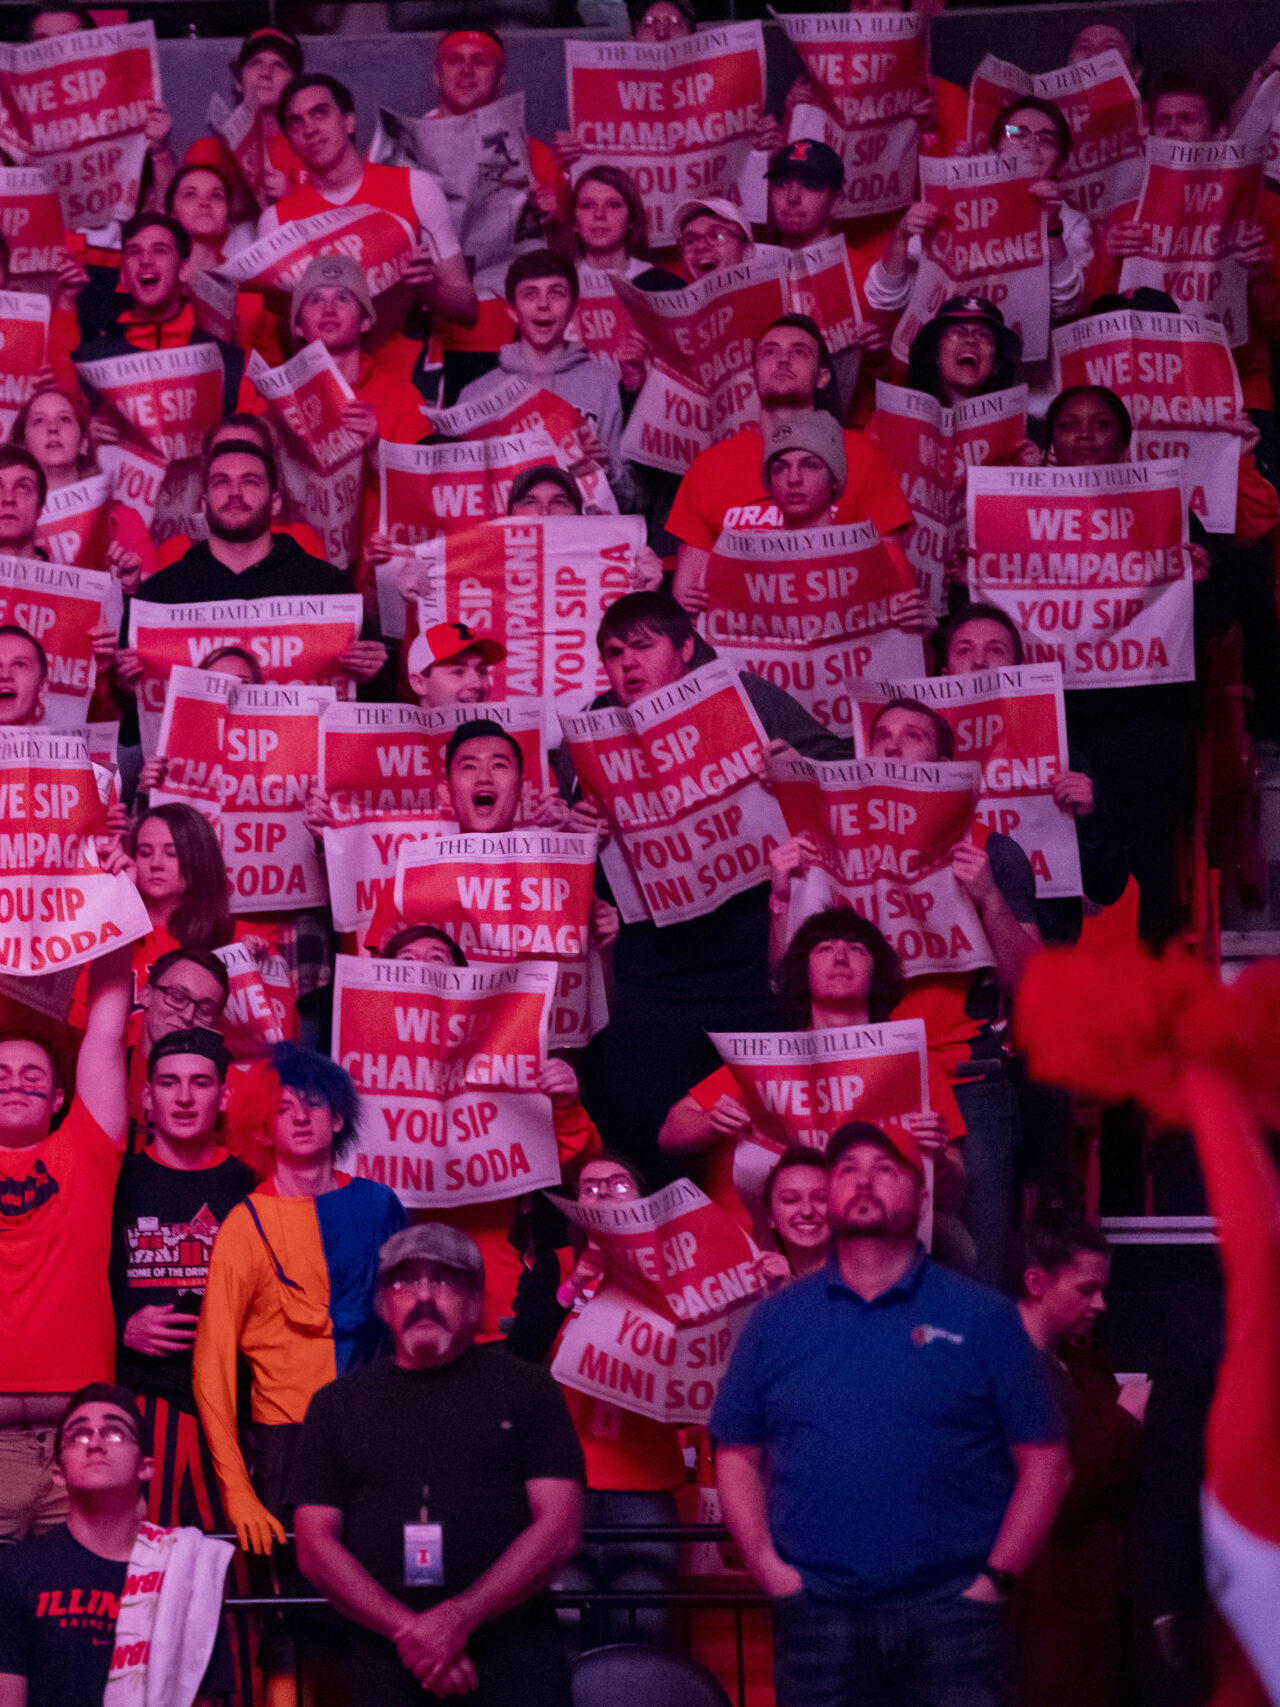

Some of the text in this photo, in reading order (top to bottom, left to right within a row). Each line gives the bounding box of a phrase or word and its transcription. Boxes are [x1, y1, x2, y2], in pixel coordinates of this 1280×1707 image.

[13, 70, 105, 113] WE SIP
[617, 74, 714, 112] WE SIP
[954, 198, 999, 230] SIP
[696, 308, 732, 344] SIP
[1086, 353, 1182, 386] WE SIP
[1006, 468, 1150, 487] THE DAILY ILLINI
[432, 483, 482, 518] WE
[723, 506, 784, 529] ORA
[763, 528, 877, 553] DAILY ILLINI
[1028, 506, 1134, 541] WE SIP
[34, 571, 79, 594] ILLINI
[744, 567, 858, 603] WE SIP
[979, 551, 1180, 583] CHAMPAGNE
[14, 598, 56, 638] SIP
[167, 601, 324, 623] THE DAILY ILLINI
[1018, 600, 1143, 631] YOU SIP
[554, 567, 587, 697] YOU SIP
[250, 637, 303, 669] SIP
[823, 645, 873, 684] SIP
[1075, 638, 1169, 674] SODA
[247, 689, 299, 707] ILLINI
[916, 671, 1021, 699] DAILY ILLINI
[353, 706, 511, 725] THE ILLINI
[572, 683, 703, 736] THE ILLINI
[228, 728, 277, 761] SIP
[959, 714, 1003, 752] SIP
[376, 744, 430, 777] WE
[599, 726, 701, 790] WE SIP
[823, 763, 941, 784] DAILY ILLINI
[33, 783, 80, 820] SIP
[867, 799, 917, 836] SIP
[234, 822, 287, 854] SIP
[695, 804, 743, 851] SIP
[436, 836, 585, 857] THE DAILY ILLINI
[702, 833, 780, 886] SODA
[227, 865, 307, 898] SODA
[456, 875, 570, 912] WE SIP
[39, 887, 86, 923] SIP
[887, 888, 934, 922] SIP
[31, 920, 123, 972] SODA
[373, 964, 466, 994] THE DAILY
[393, 1006, 441, 1046] WE
[730, 1029, 883, 1056] THE ILLINI
[341, 1050, 537, 1092] CHAMPAGNE
[756, 1074, 864, 1116] WE SIP
[381, 1101, 498, 1149] YOU SIP
[354, 1141, 530, 1194] MINI SODA
[663, 1230, 697, 1277] SIP
[616, 1309, 732, 1369] YOU SIP
[578, 1342, 656, 1403] MINI
[36, 1588, 122, 1619] ILLIN
